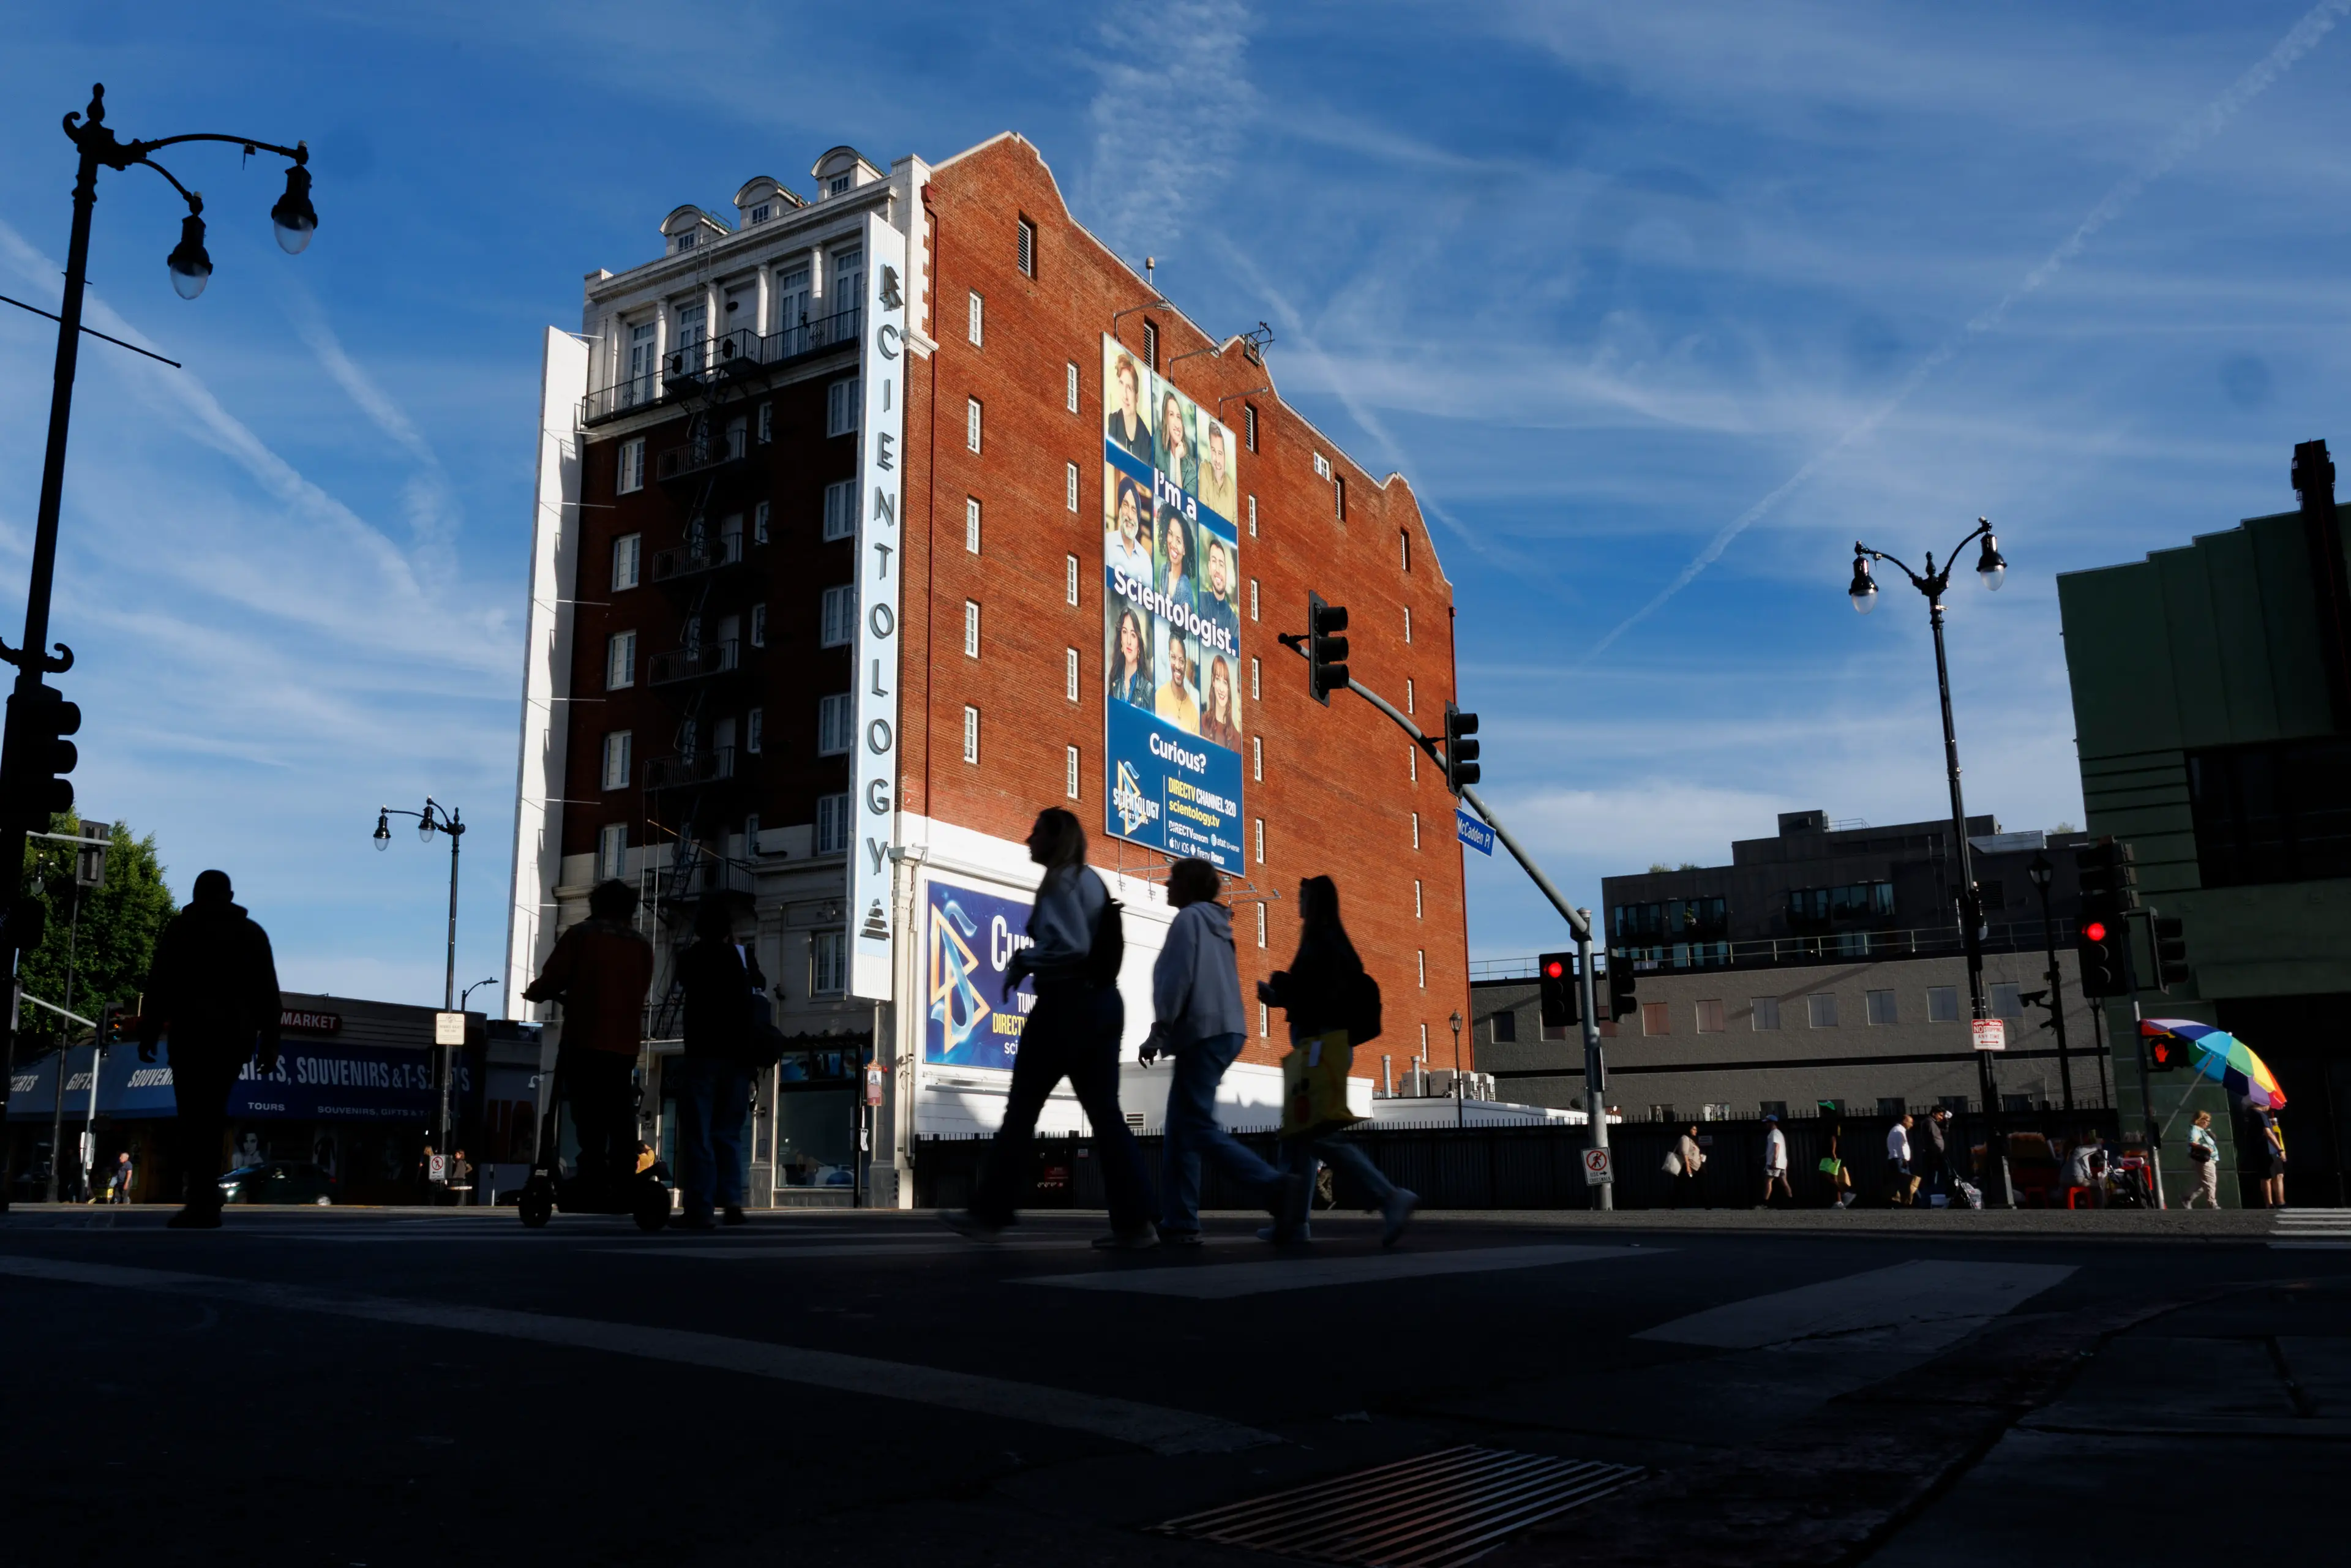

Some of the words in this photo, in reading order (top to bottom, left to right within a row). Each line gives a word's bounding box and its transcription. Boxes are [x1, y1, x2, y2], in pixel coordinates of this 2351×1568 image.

[1154, 467, 1180, 511] I'm
[1187, 497, 1196, 521] a
[1114, 565, 1236, 656] Scientologist.
[1150, 733, 1206, 774] Curious?
[1169, 777, 1196, 801] DIRECTV
[1196, 788, 1224, 813] CHANNEL
[1224, 799, 1236, 817] 320
[1169, 800, 1220, 828] scientology.tv
[1174, 839, 1180, 850] tv
[1458, 817, 1483, 845] McCadden
[1485, 833, 1491, 849] Pl
[280, 1011, 337, 1029] MARKET
[296, 1056, 390, 1088] SOUVENIRS
[392, 1067, 403, 1089] &
[248, 1102, 287, 1112] TOURS
